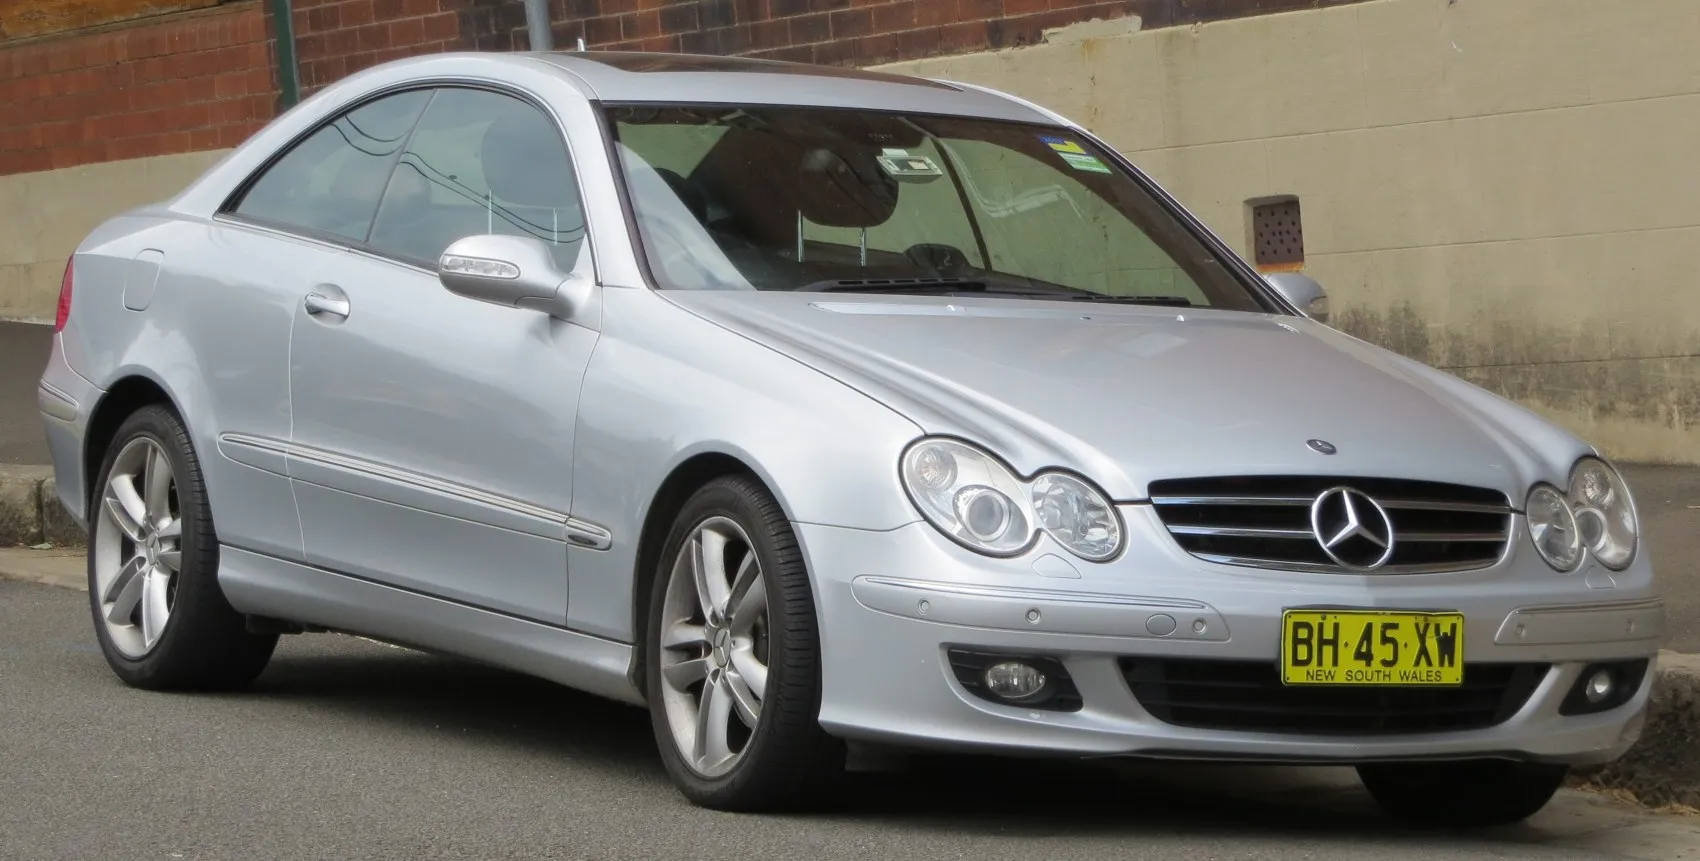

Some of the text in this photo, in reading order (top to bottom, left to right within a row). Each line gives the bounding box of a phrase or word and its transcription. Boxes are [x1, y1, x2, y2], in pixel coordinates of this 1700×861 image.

[1305, 669, 1442, 682] NEW SOUTH WALES
